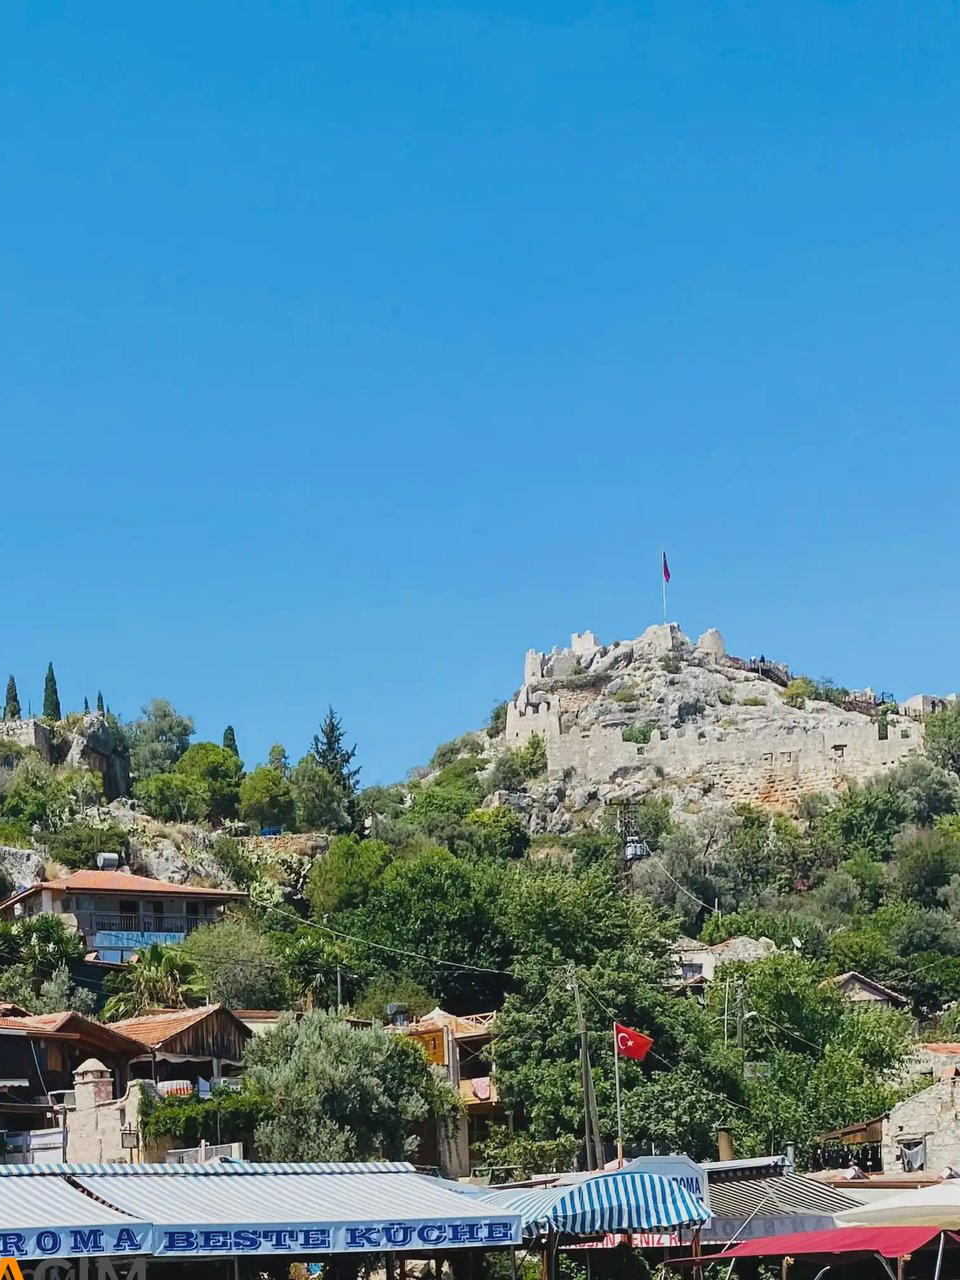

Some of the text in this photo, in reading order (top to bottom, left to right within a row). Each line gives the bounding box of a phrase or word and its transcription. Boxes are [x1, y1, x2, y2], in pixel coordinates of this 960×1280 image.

[0, 1228, 142, 1258] ROMA
[163, 1228, 331, 1252] BESTE
[346, 1222, 513, 1249] KÜCHE
